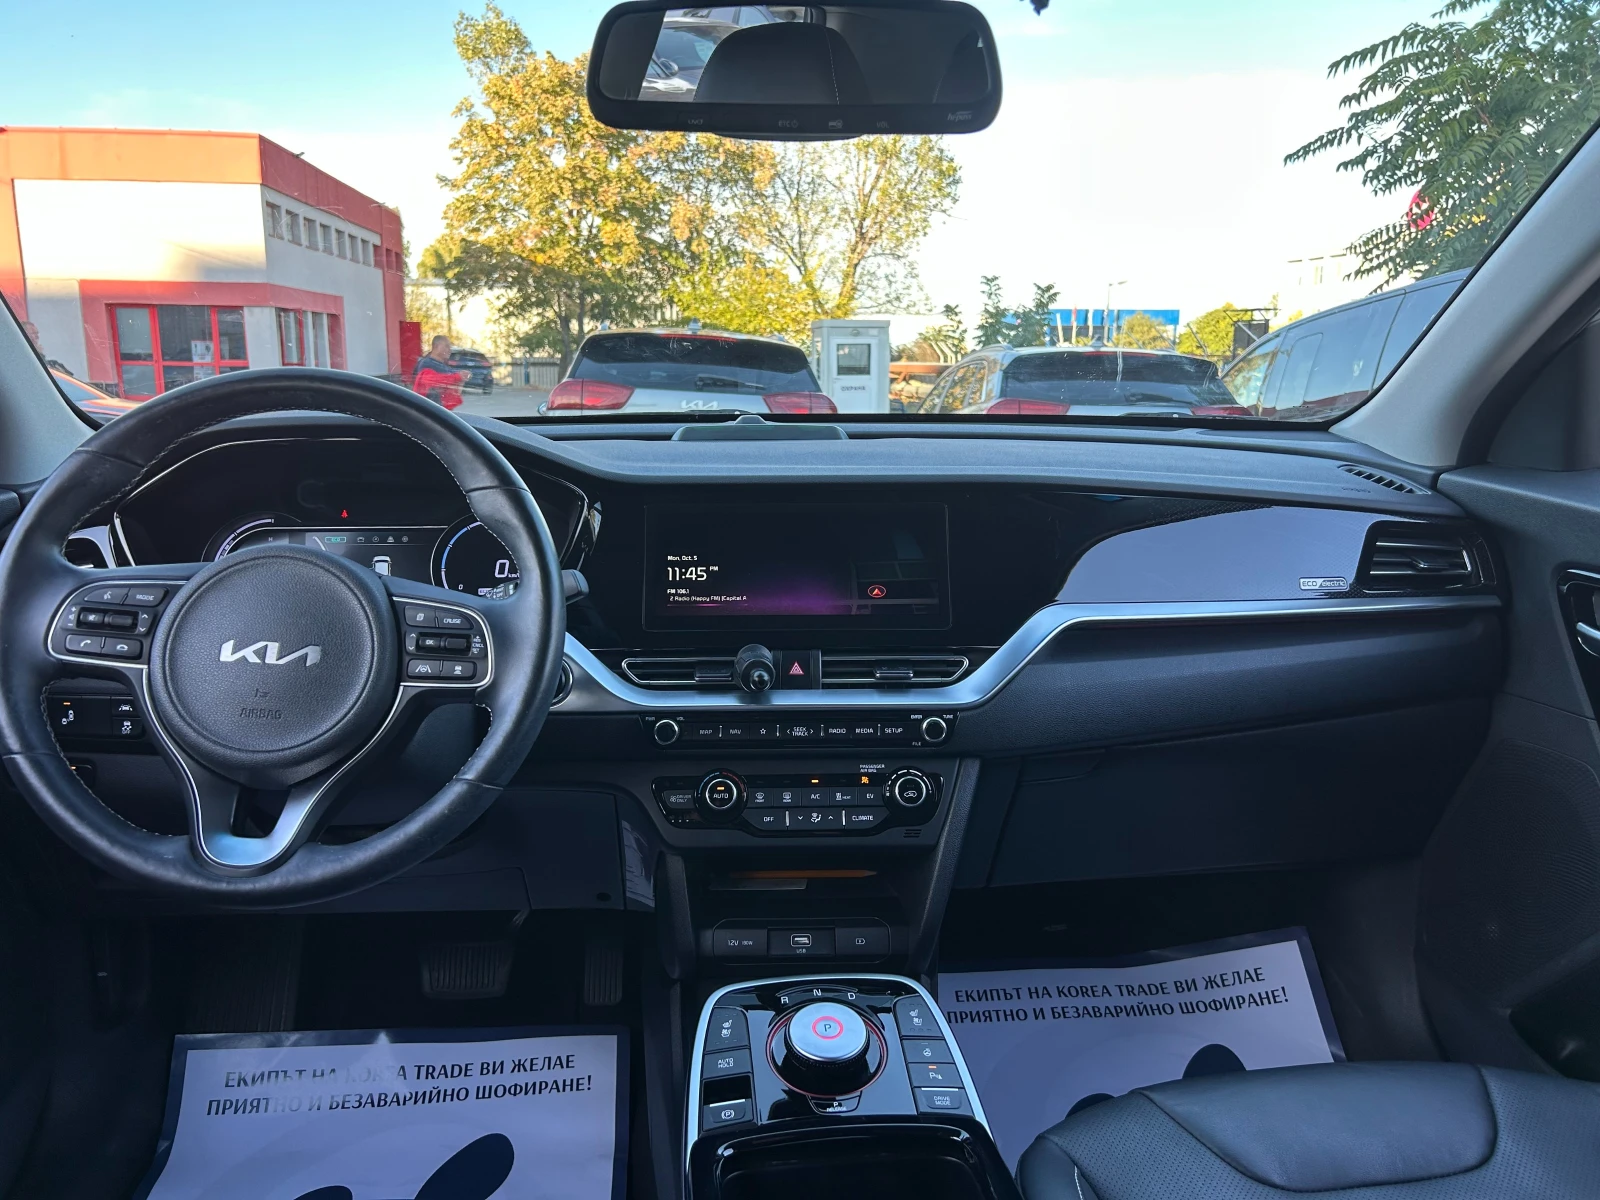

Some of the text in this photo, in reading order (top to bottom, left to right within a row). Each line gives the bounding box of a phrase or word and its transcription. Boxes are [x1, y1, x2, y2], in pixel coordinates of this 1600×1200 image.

[876, 120, 890, 129] VOL
[494, 559, 510, 578] 0
[667, 566, 707, 581] 11:45
[219, 639, 322, 667] KIA
[239, 707, 283, 720] AIRBAG
[954, 966, 1265, 1003] ЕКИПЪТ НА KOREA TRADE ВИ ЖЕЛАЕ
[780, 996, 789, 1004] R
[847, 992, 856, 1000] D
[946, 986, 1289, 1024] ПРИЯТНО И БЕЗАВАРИЙНО ШОФИРАНЕ!
[823, 1023, 832, 1033] P
[224, 1069, 306, 1088] ЕКИПЪТ
[414, 1062, 474, 1080] TRADE
[479, 1060, 505, 1076] ВИ
[510, 1054, 575, 1074] ЖЕЛАЕ
[206, 1074, 592, 1116] ПРИЯТНО И БЕЗАВАРИЙНО ШОФИРАНЕ!
